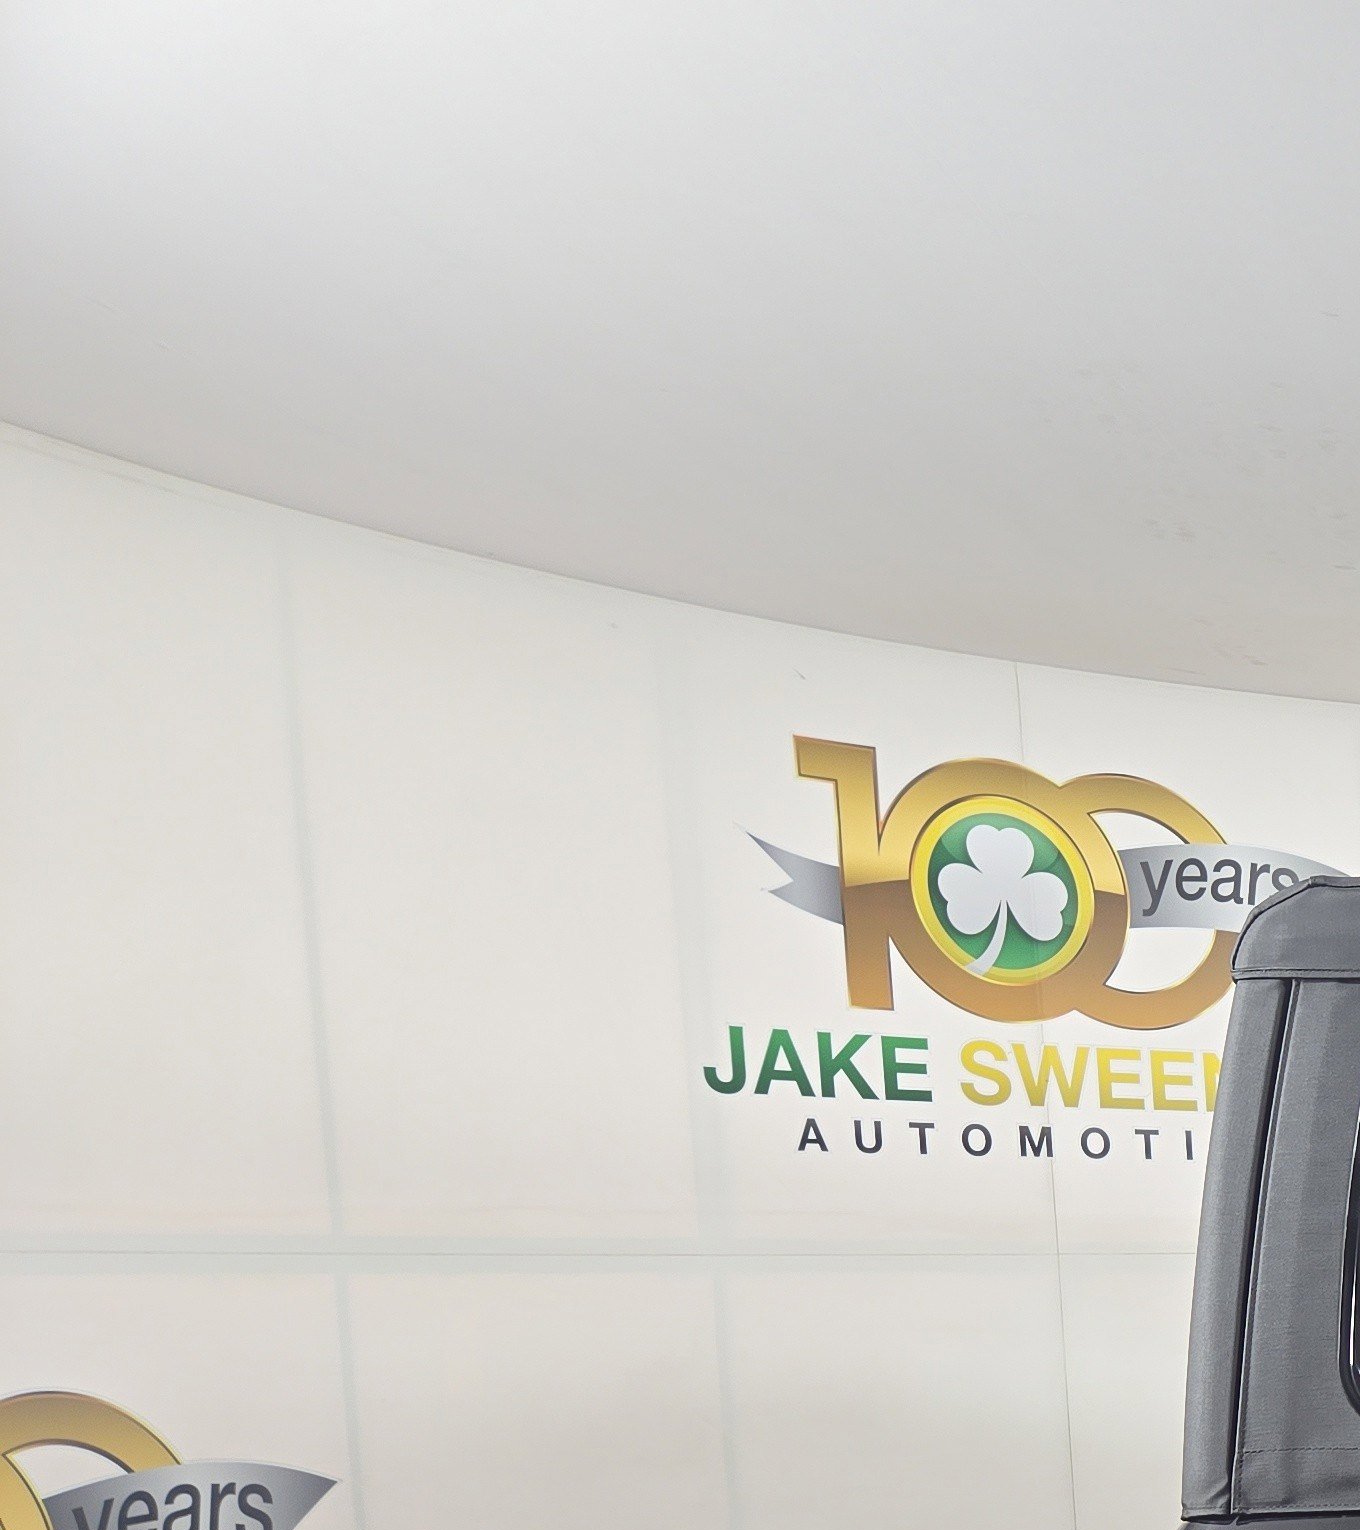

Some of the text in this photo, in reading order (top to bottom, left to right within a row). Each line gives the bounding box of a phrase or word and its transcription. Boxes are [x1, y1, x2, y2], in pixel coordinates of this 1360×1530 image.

[793, 733, 1240, 1030] 100
[703, 1025, 933, 1102] JAKE
[797, 1117, 1194, 1161] AUTOMOTI
